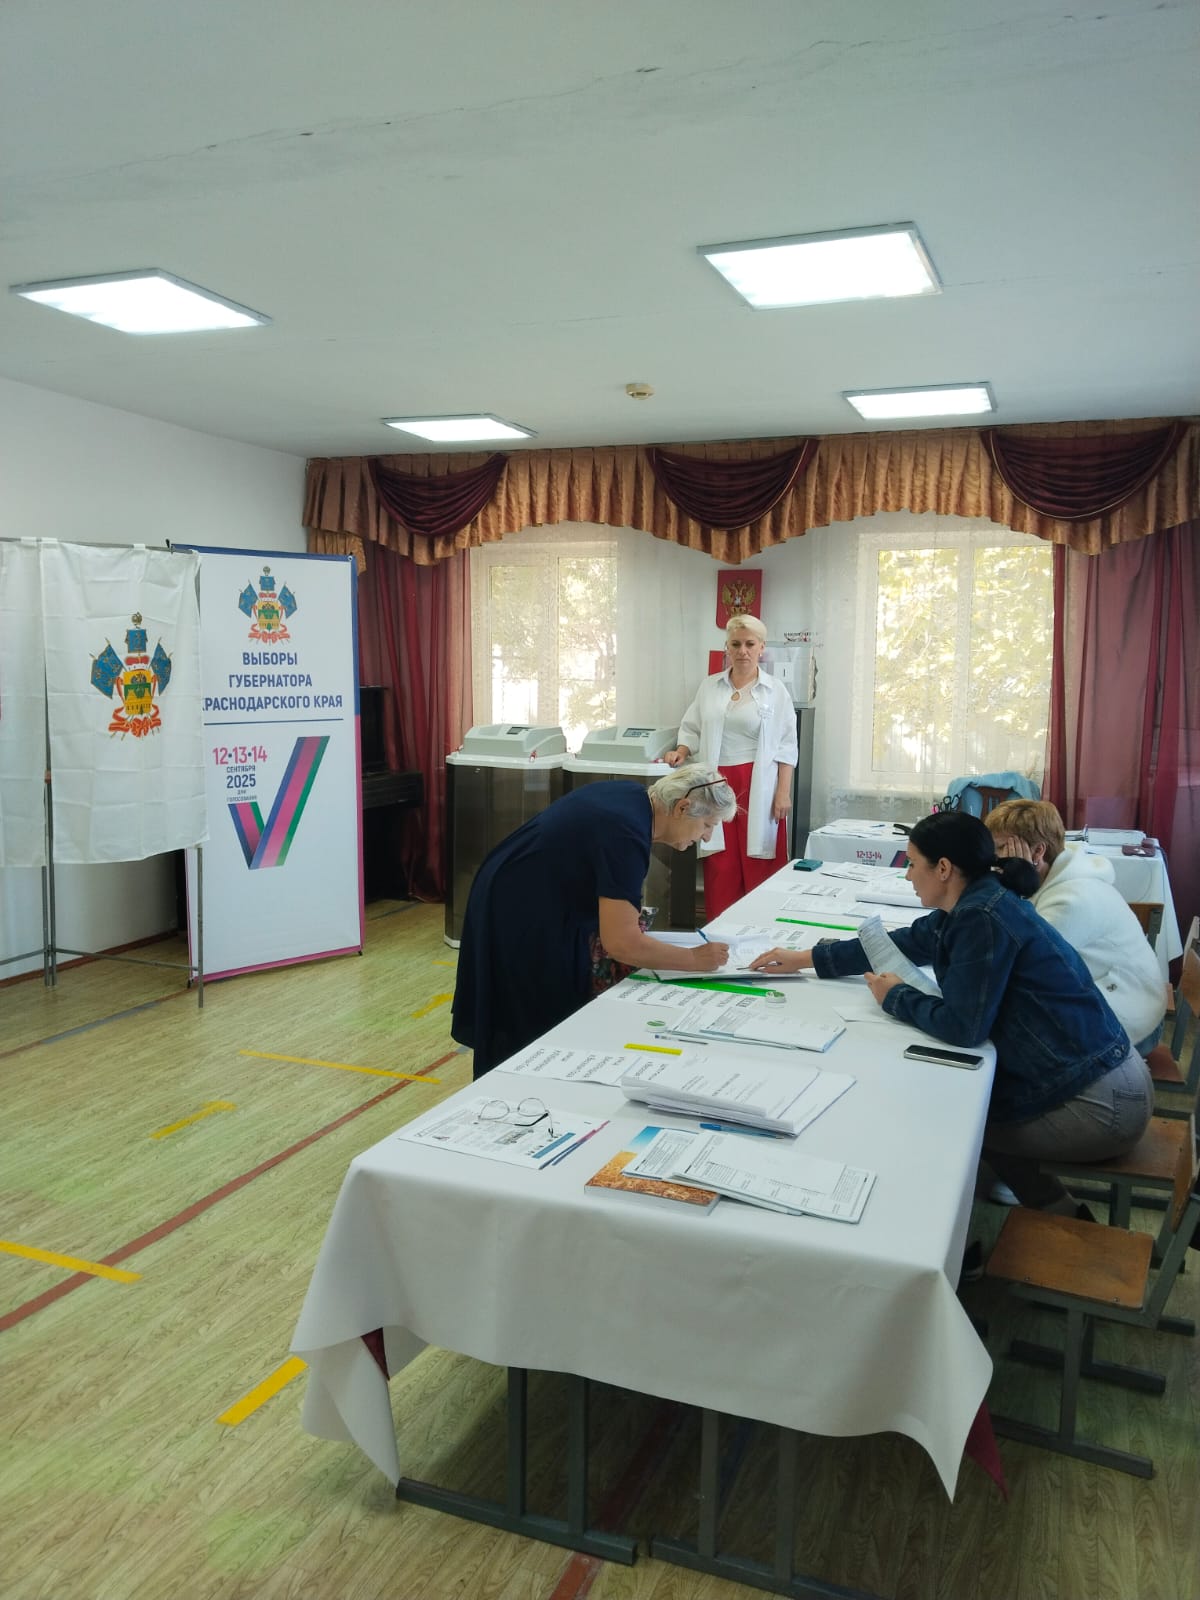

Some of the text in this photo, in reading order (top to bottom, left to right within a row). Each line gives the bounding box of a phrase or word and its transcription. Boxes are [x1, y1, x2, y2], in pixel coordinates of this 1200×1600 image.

[242, 652, 298, 666] ВЫБОРЫ
[228, 674, 312, 688] ГУБЕРНАТОРА
[202, 695, 343, 712] РАСНОДАРСКОГО КРАЯ
[226, 765, 256, 773] СЕНТЯБРЯ
[226, 774, 256, 789] 2025
